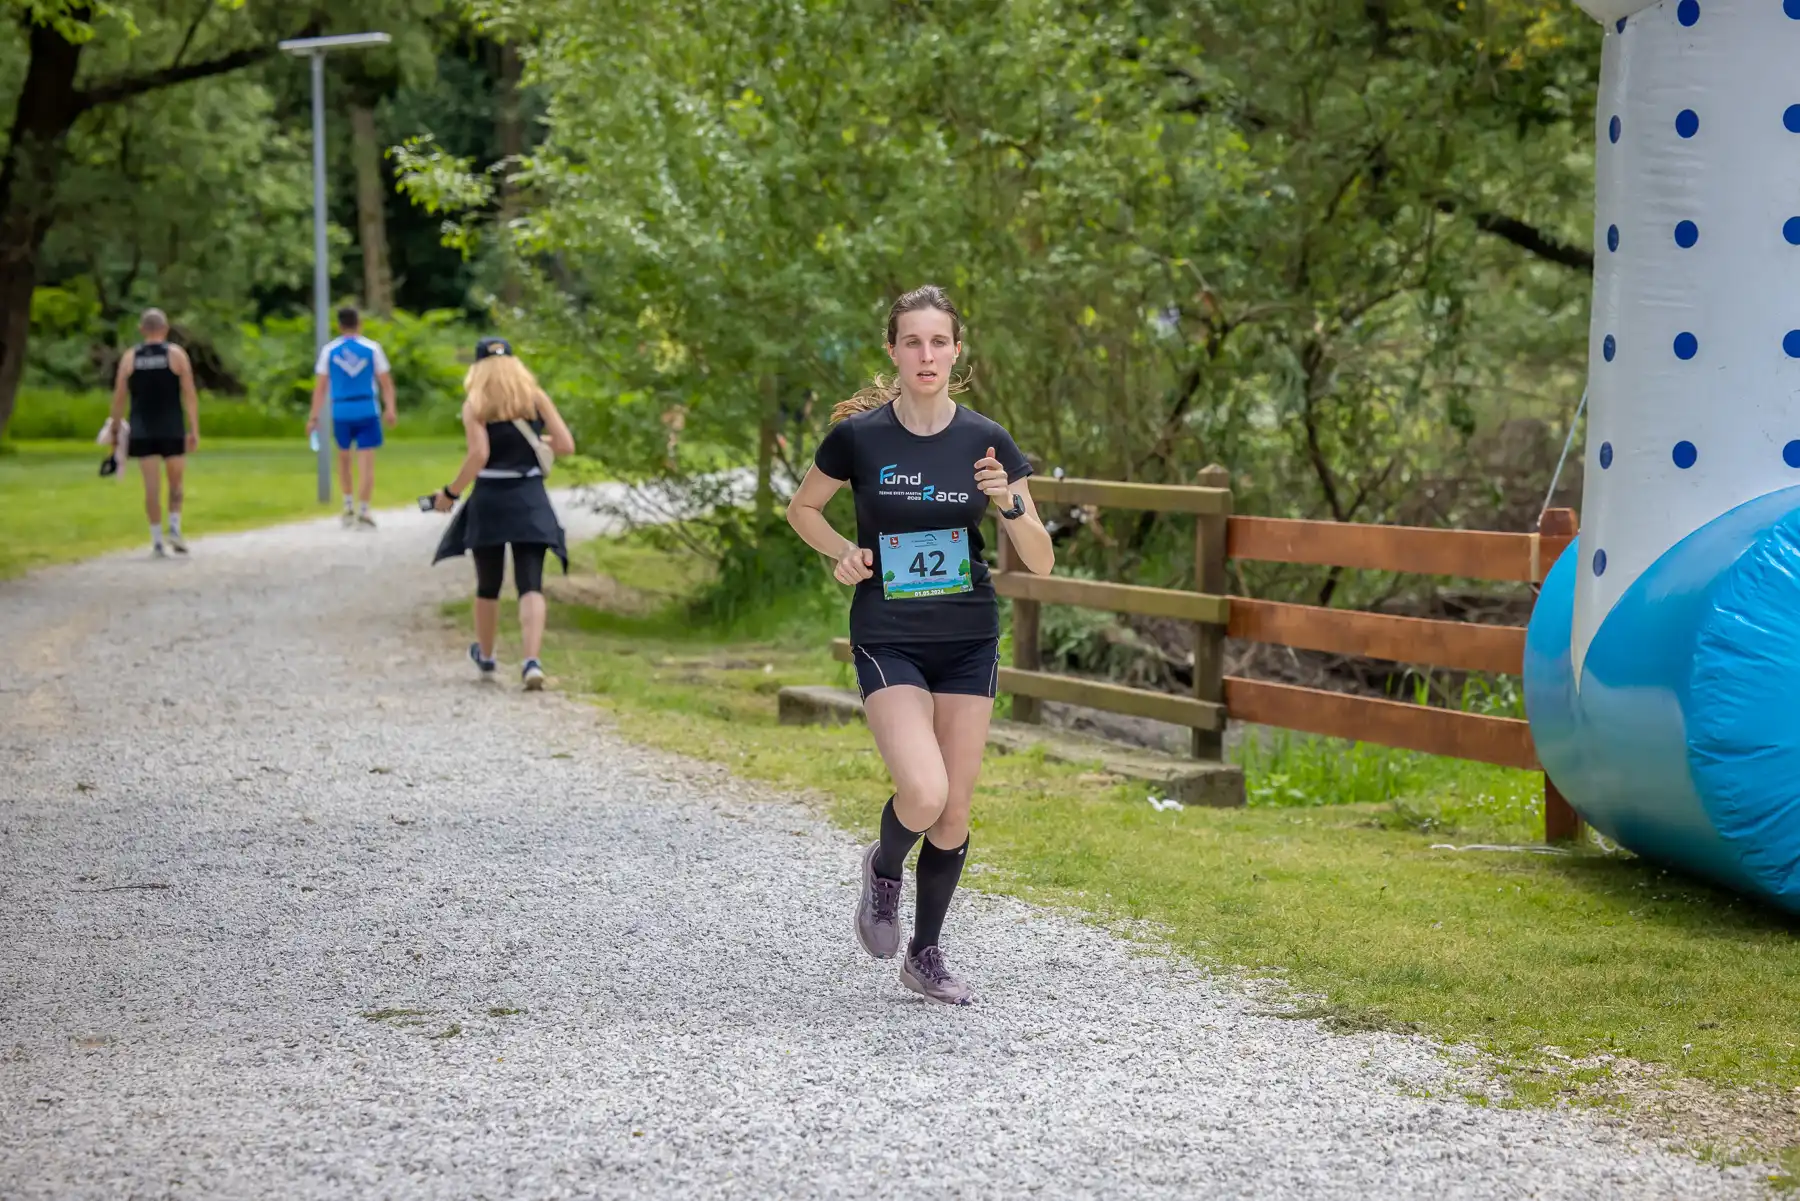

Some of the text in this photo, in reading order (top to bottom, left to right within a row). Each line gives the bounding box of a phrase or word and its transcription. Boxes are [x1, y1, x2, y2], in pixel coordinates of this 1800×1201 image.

[879, 464, 921, 485] Fund
[923, 485, 969, 503] Race
[908, 550, 947, 577] 42
